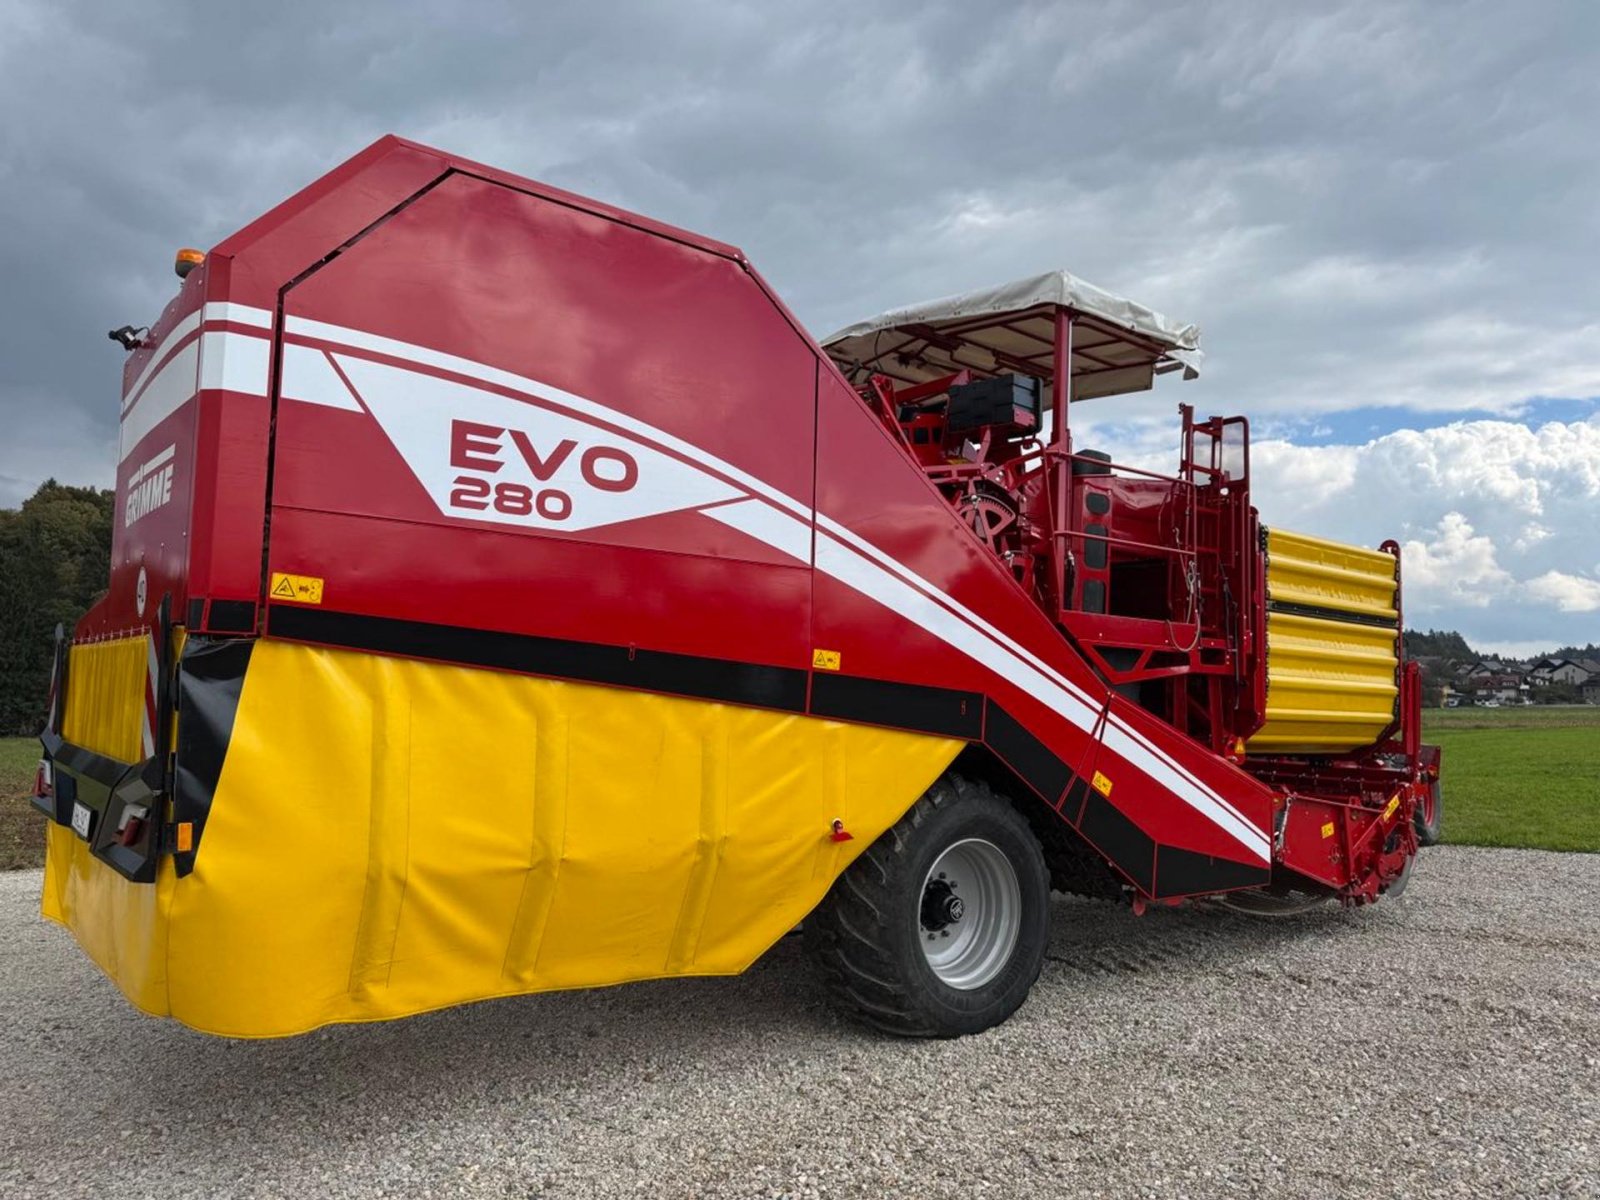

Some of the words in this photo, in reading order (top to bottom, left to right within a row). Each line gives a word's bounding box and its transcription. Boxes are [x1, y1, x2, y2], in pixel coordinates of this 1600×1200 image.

[450, 419, 639, 492] EVO
[125, 463, 174, 528] GRIMME
[450, 475, 573, 521] 280
